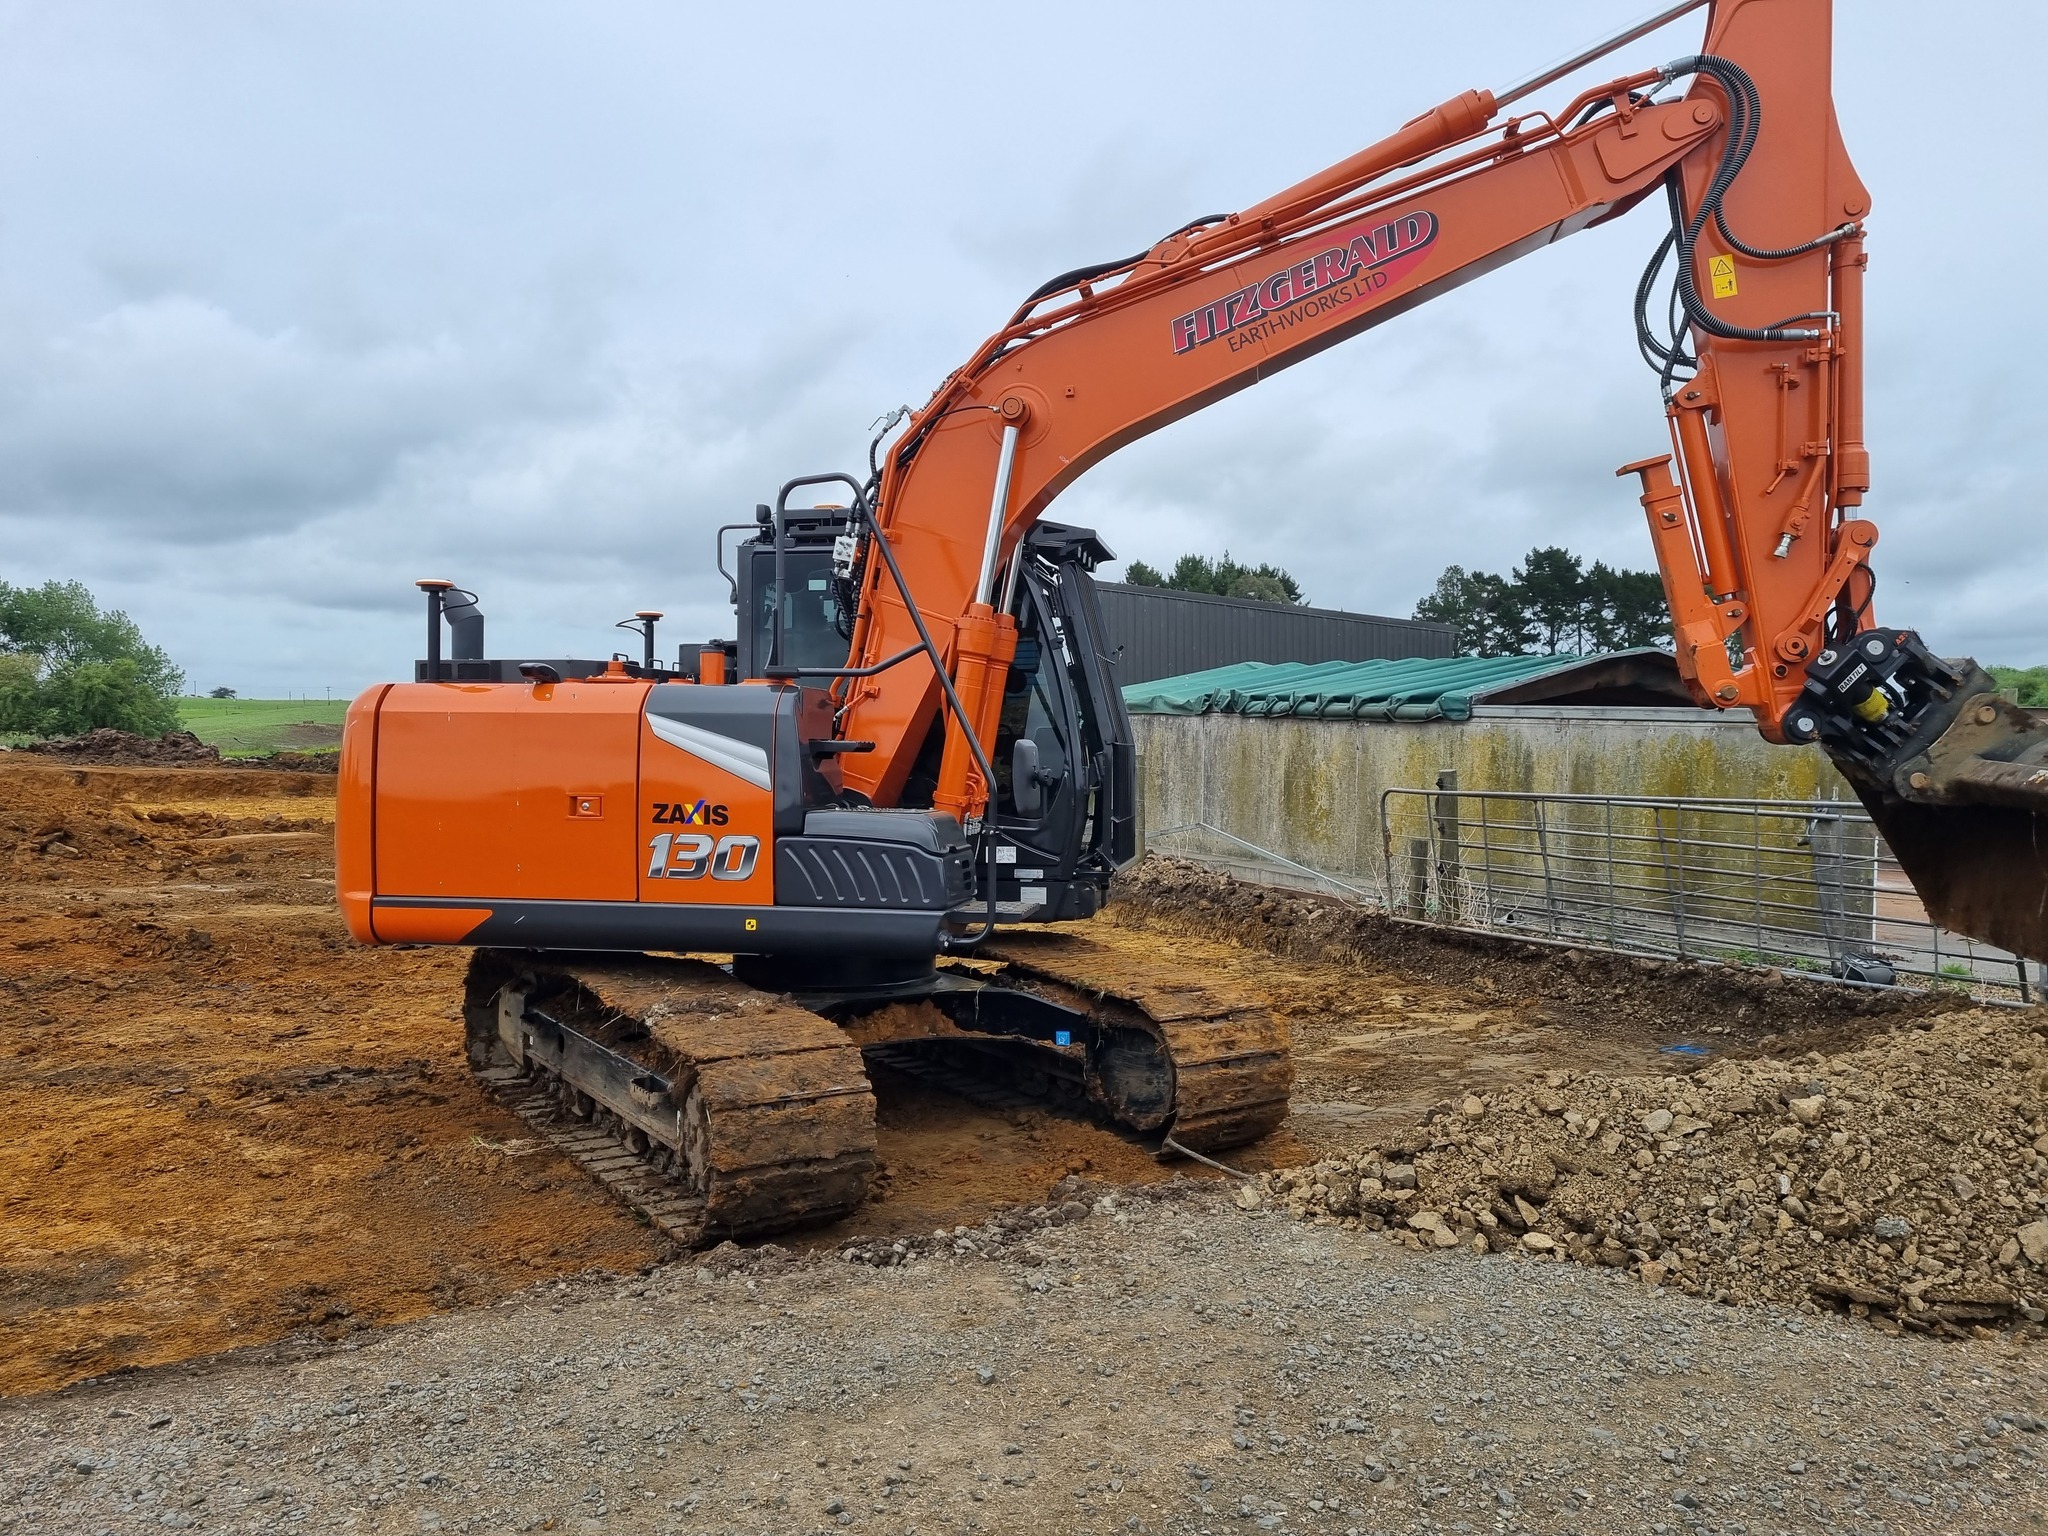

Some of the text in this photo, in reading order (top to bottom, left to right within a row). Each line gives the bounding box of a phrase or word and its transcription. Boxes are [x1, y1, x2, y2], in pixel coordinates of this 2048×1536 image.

[1171, 210, 1439, 355] FITZGERALD
[1227, 271, 1388, 352] EARTHWORKS LTD
[652, 799, 729, 826] ZAXIS
[648, 832, 761, 881] 130
